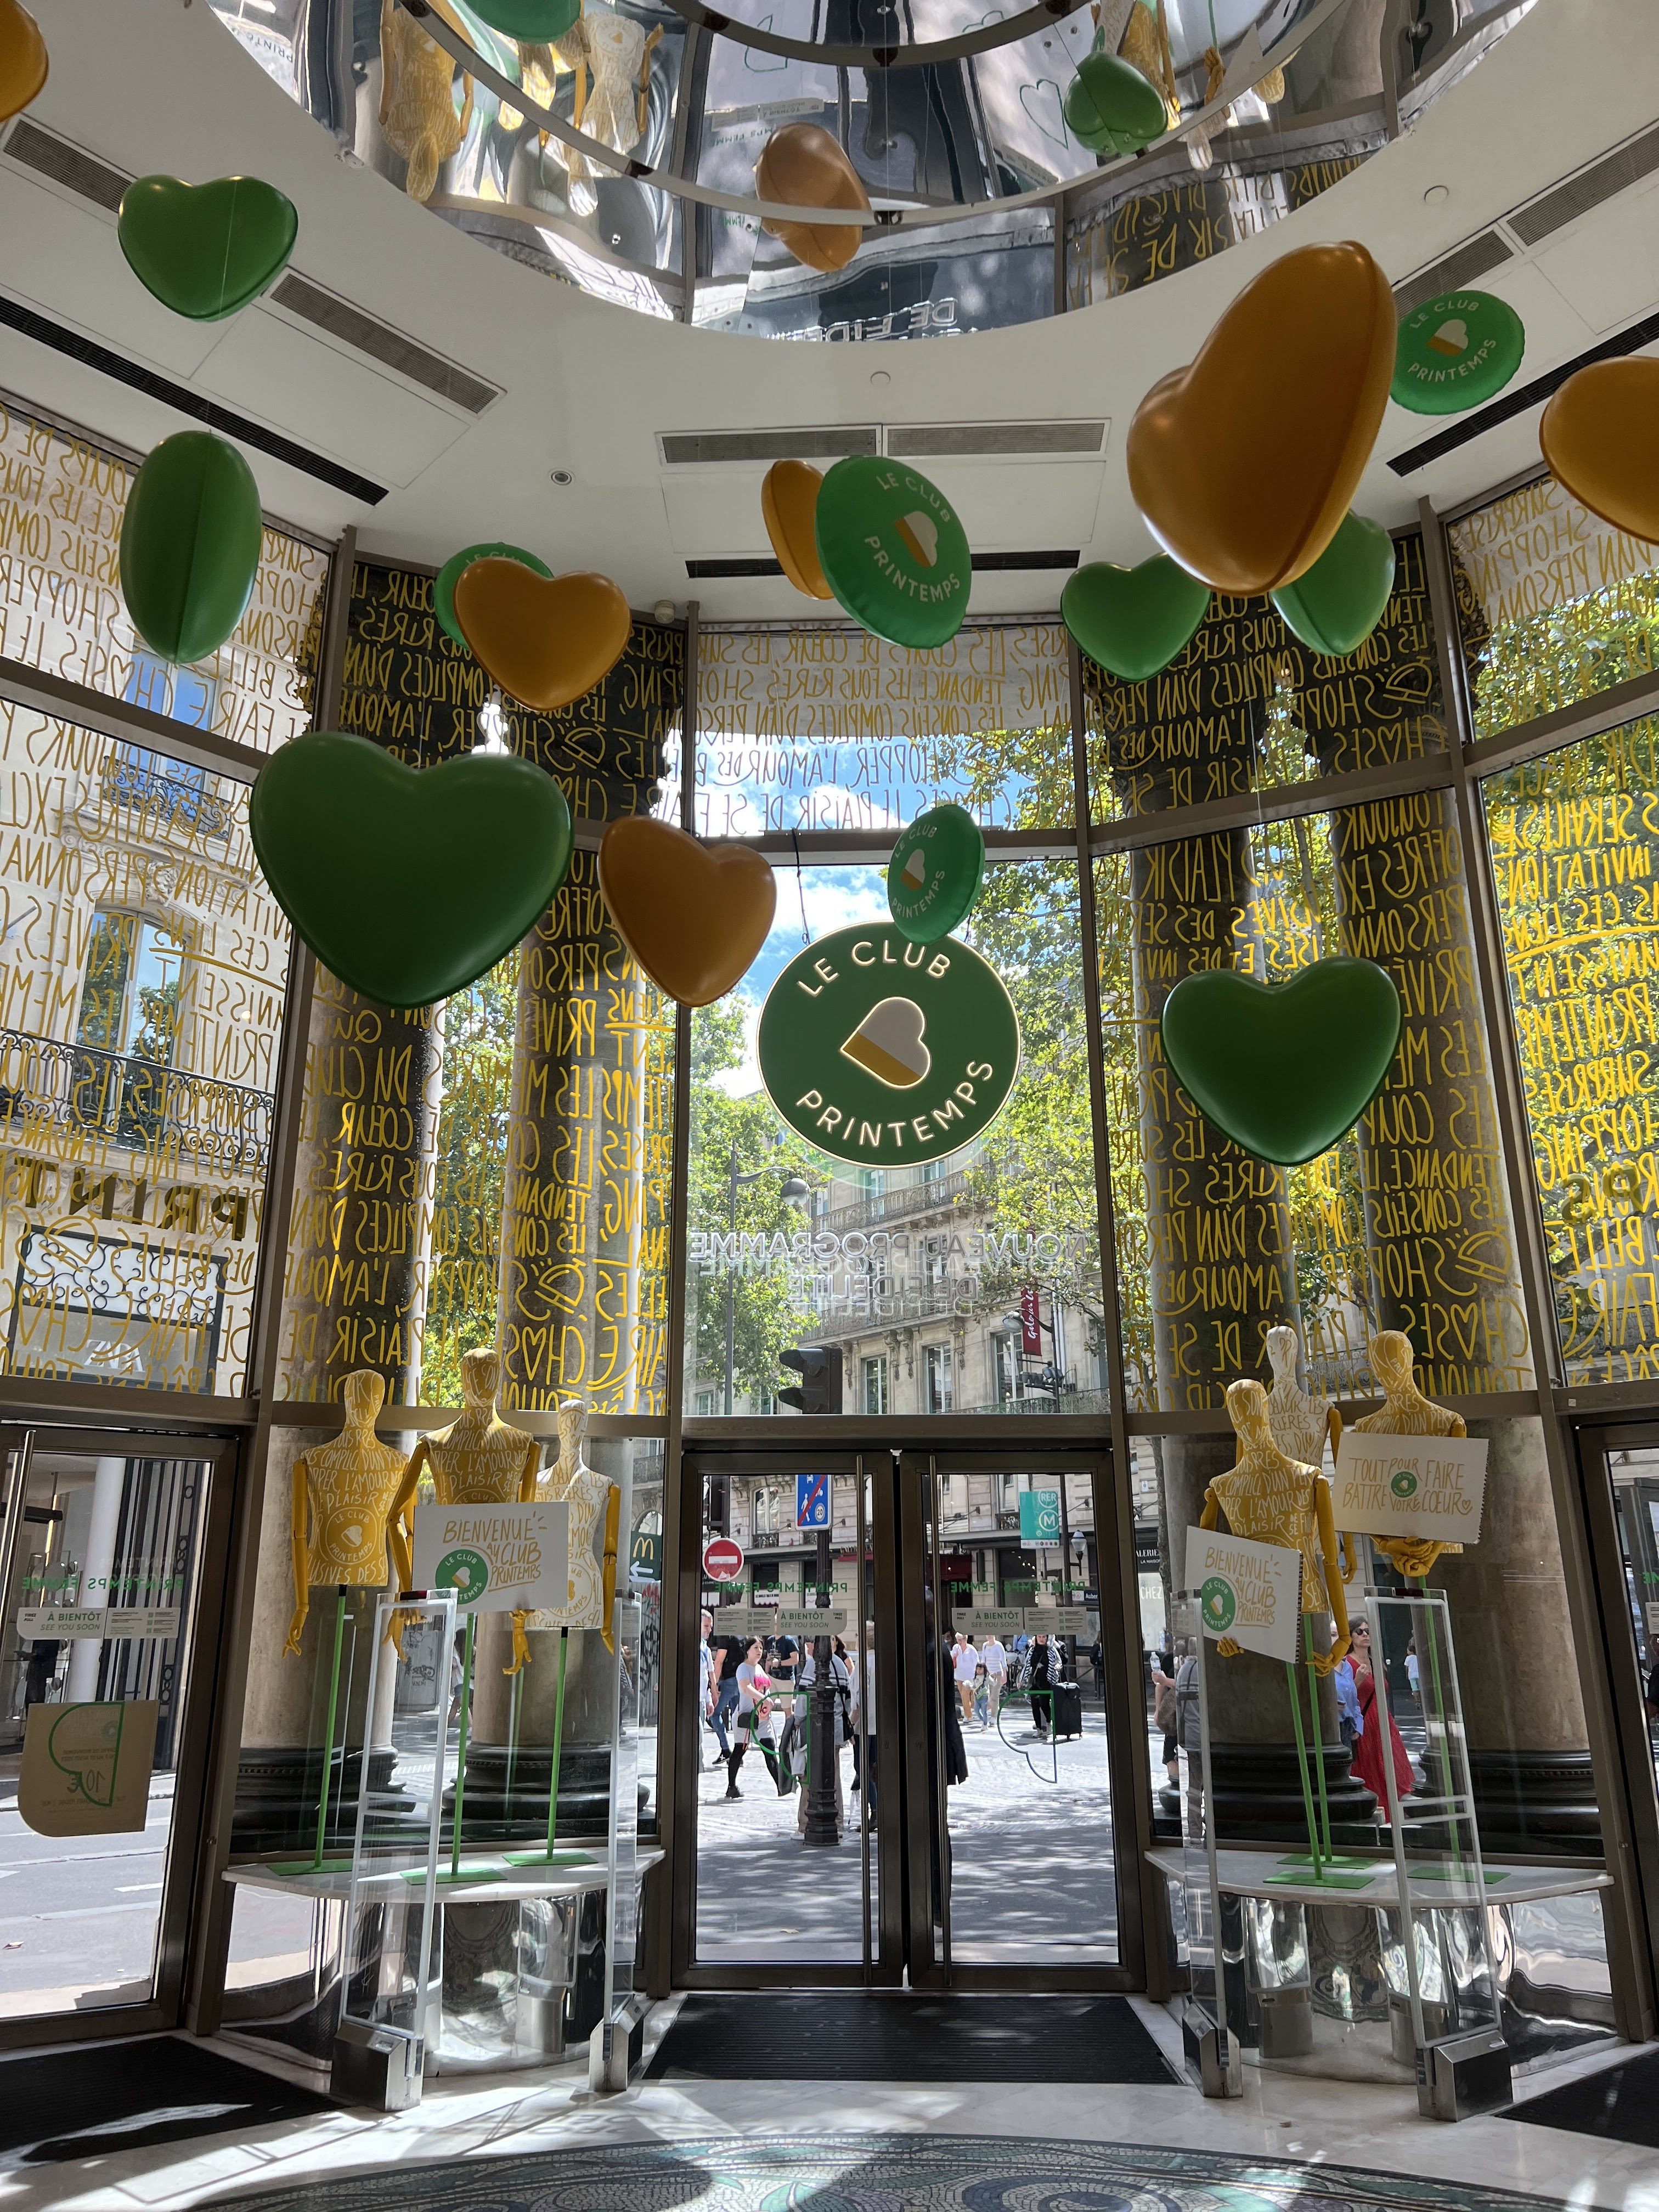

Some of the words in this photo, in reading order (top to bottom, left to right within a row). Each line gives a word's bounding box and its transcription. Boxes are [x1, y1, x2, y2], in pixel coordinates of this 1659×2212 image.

[1409, 312, 1429, 329] LE
[1434, 300, 1480, 312] CLUB
[1407, 339, 1497, 382] PRINTEMPS
[876, 472, 899, 490] LE
[905, 476, 951, 522] CLUB
[864, 535, 961, 603] PRINTEMPS
[895, 840, 906, 859] LE
[909, 825, 937, 840] CLUB
[891, 870, 945, 918] PRINTEMPS
[797, 957, 839, 997] LE
[851, 939, 951, 979] CLUB
[795, 1060, 994, 1148] PRINTEMPS
[1347, 1457, 1389, 1482] TOUT
[1387, 1458, 1423, 1482] POUR
[1425, 1460, 1465, 1490] FAIRE
[1041, 1493, 1057, 1502] RER
[1342, 1482, 1387, 1510] BATTRE
[1389, 1491, 1422, 1513] VOTRE
[334, 1513, 345, 1524] LE
[347, 1510, 370, 1524] CLUB
[1043, 1514, 1056, 1527] M
[443, 1517, 536, 1544] BIENVENUE
[329, 1541, 373, 1562] PRINTEMPS
[445, 1556, 455, 1566] LE
[456, 1554, 478, 1565] CLUB
[487, 1542, 501, 1562] AU
[500, 1542, 542, 1566] CLUB
[489, 1564, 541, 1587] PRINTEMPS
[1205, 1547, 1273, 1584] BIENVENUE
[1140, 1586, 1163, 1600] CHEZ
[1206, 1582, 1214, 1591] LE
[1213, 1581, 1228, 1594] CLUB
[1235, 1576, 1245, 1599] AU
[1245, 1580, 1277, 1609] CLUB
[48, 1611, 54, 1621] À
[58, 1611, 101, 1622] BIENTÔT
[781, 1611, 786, 1620] À
[789, 1610, 824, 1620] BIENTÔT
[975, 1611, 981, 1620] À
[984, 1610, 1019, 1620] BIENTÔT
[1203, 1609, 1232, 1628] PRINTEMPS
[1235, 1601, 1276, 1625] PRINTEMPS
